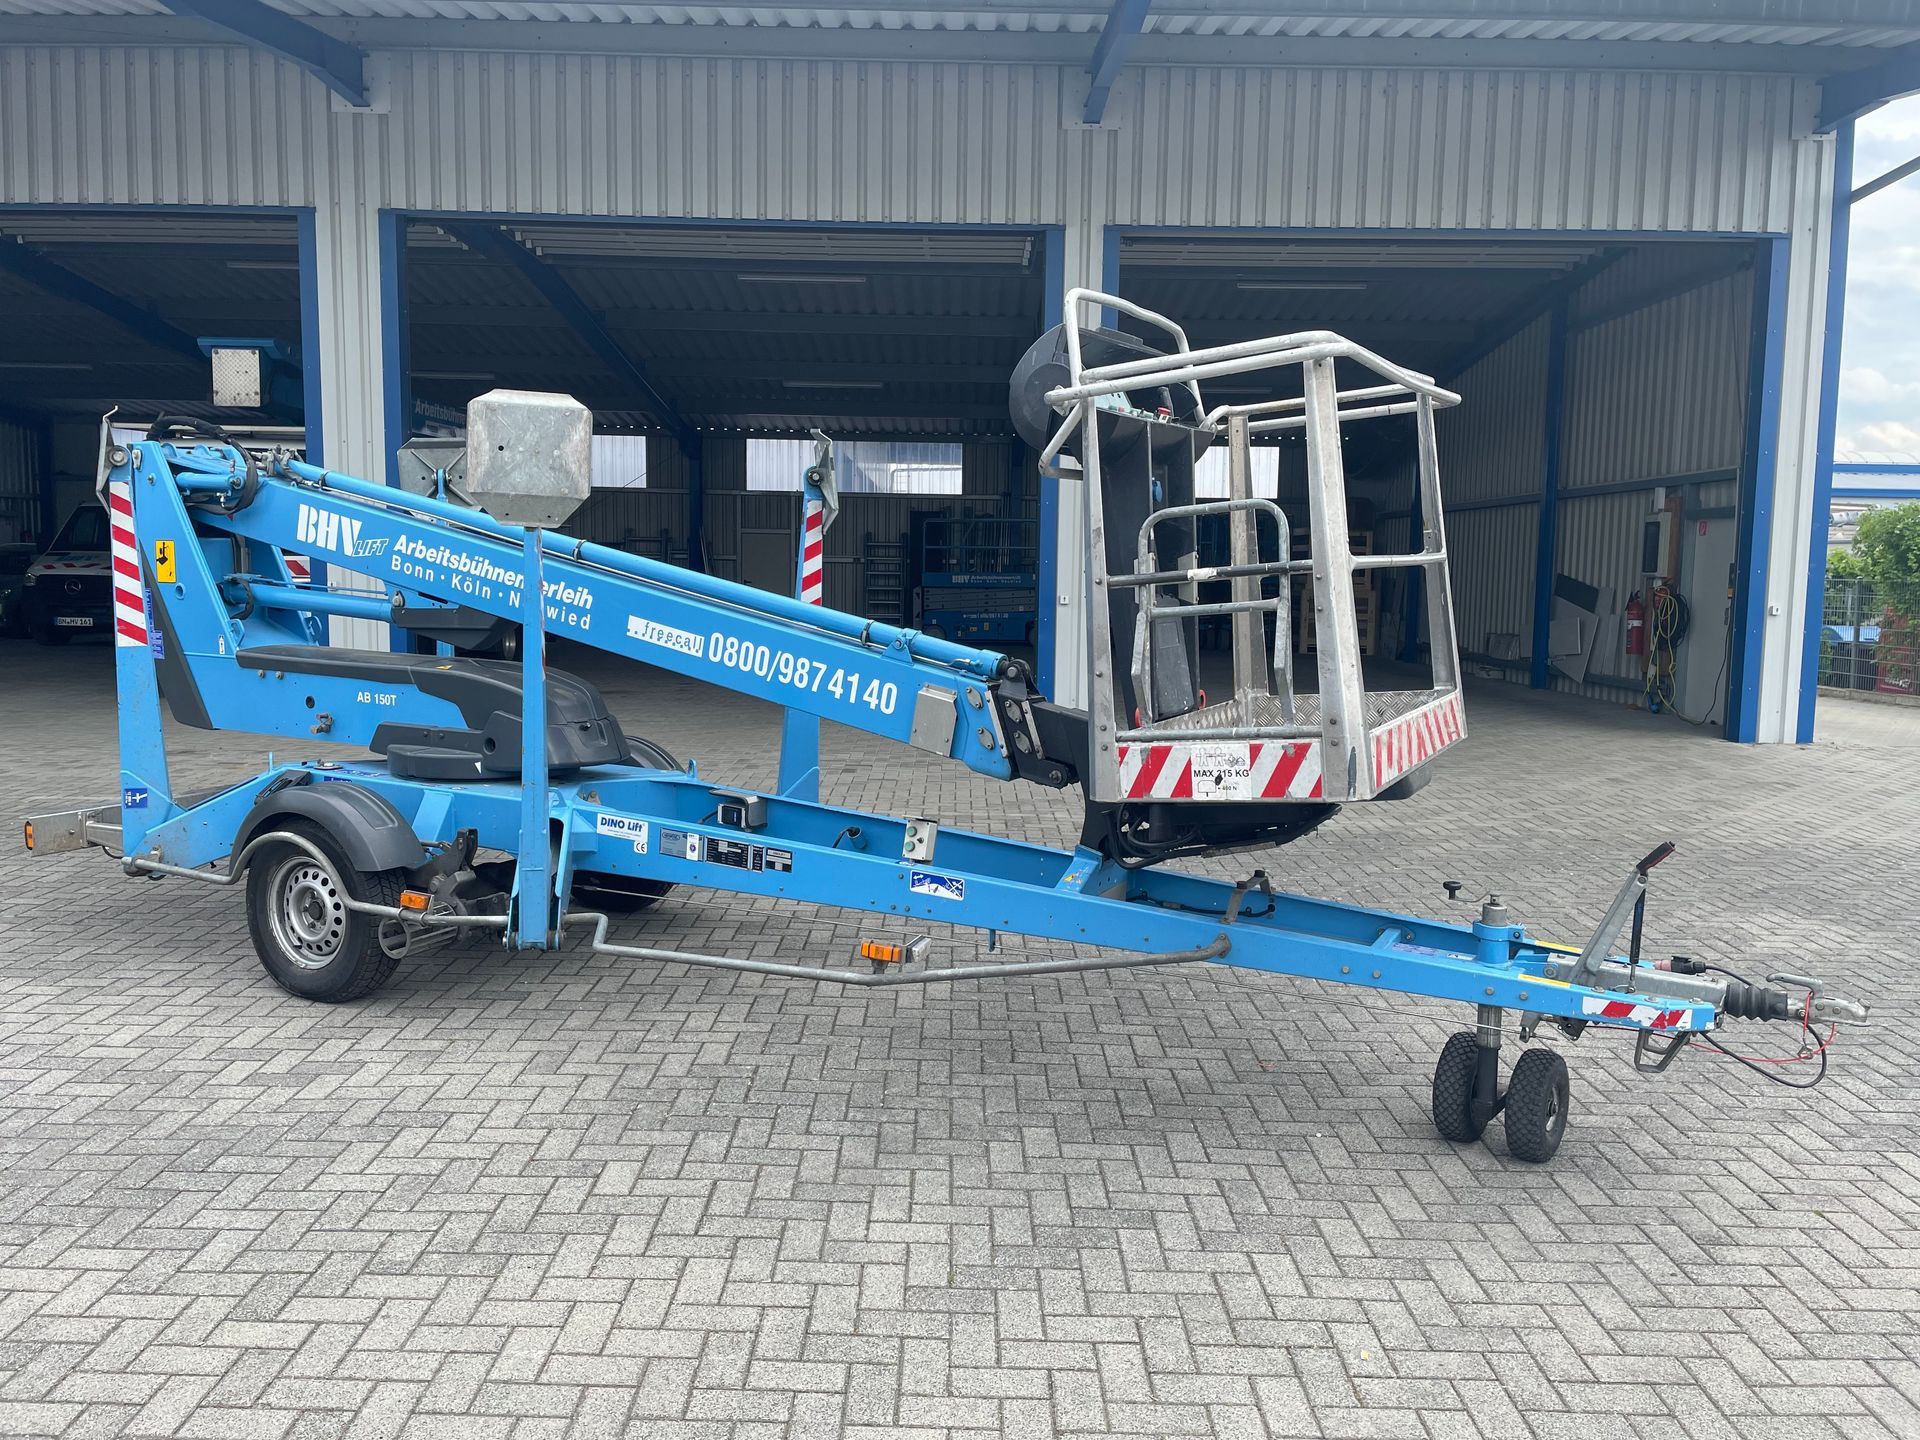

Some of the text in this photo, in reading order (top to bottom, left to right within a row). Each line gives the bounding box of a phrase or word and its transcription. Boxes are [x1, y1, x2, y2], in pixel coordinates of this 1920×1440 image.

[296, 503, 390, 558] BHV LIFT
[391, 554, 591, 630] Bonn Köln Nwied
[393, 534, 594, 610] Arbeitsbühnenerleih
[356, 691, 398, 707] AB 150T
[708, 631, 898, 715] 0800/9874140
[1193, 769, 1215, 778] MAX
[1235, 769, 1250, 778] KG
[600, 816, 626, 830] DINO
[627, 821, 643, 833] Lift
